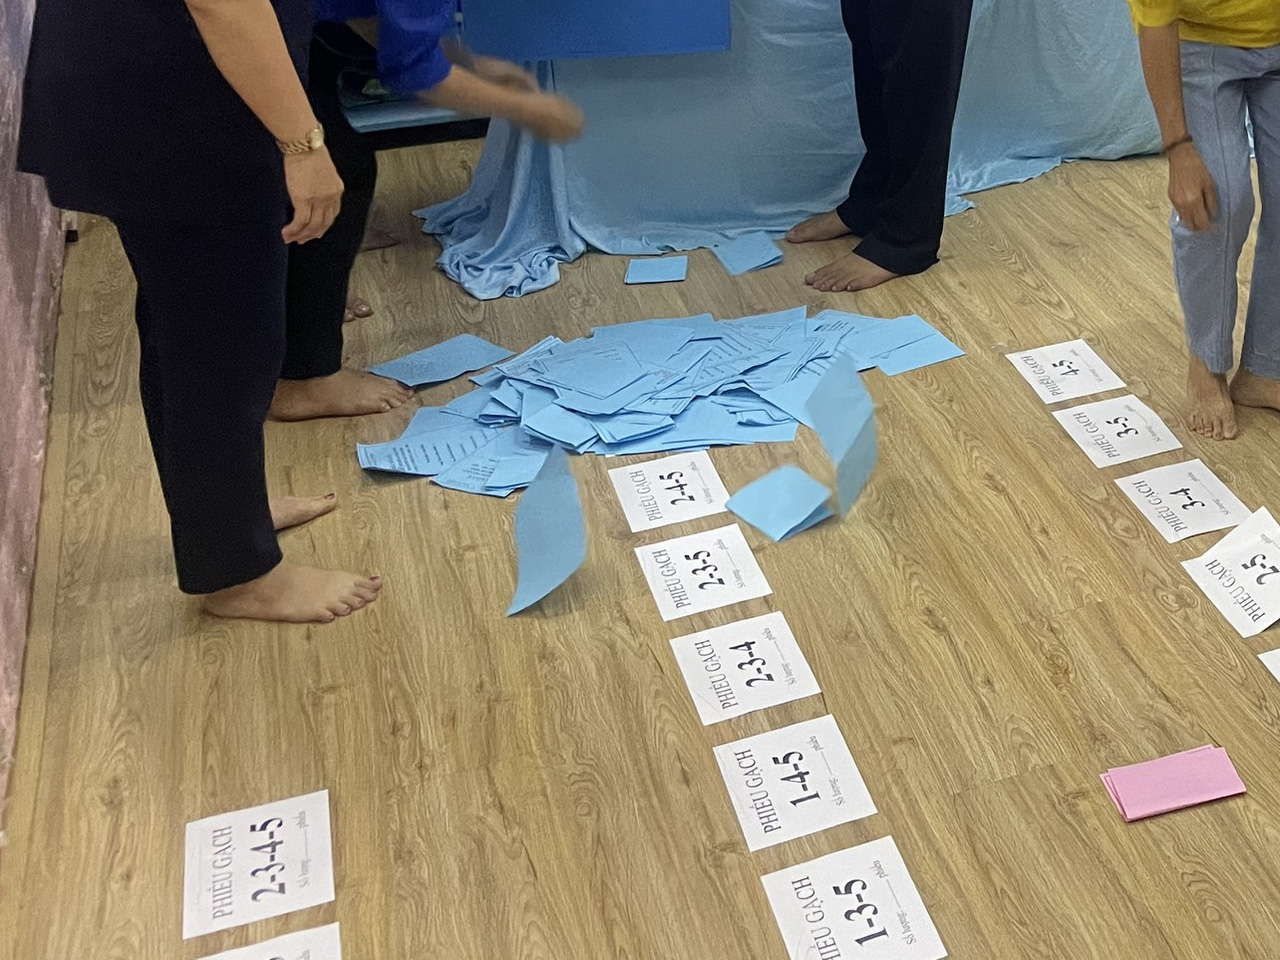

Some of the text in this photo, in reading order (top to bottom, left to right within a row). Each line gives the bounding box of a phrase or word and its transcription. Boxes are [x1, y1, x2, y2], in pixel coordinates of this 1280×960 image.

[1051, 360, 1080, 375] 4-5
[1105, 417, 1139, 438] 3-5
[659, 471, 695, 505] 2-4-5
[1132, 480, 1188, 532] PHIẾU GẠCH
[1169, 488, 1205, 510] 3-4
[652, 549, 691, 609] PHIẾU GẠCH
[684, 550, 725, 590] 2-3-5
[1205, 559, 1266, 622] PHIẾU GẠCH
[1241, 554, 1280, 585] 2-5
[694, 640, 739, 710] PHIẾU GẠCH
[729, 641, 774, 687] 2-3-4
[734, 749, 781, 834] PHIẾU GẠCH
[772, 751, 821, 807] 1-4-5
[208, 826, 236, 919] PHIẾU GẠCH
[250, 817, 286, 902] 2-3-4-5
[791, 876, 841, 960] HIẾU GẠCH
[832, 879, 889, 947] 1-3-5
